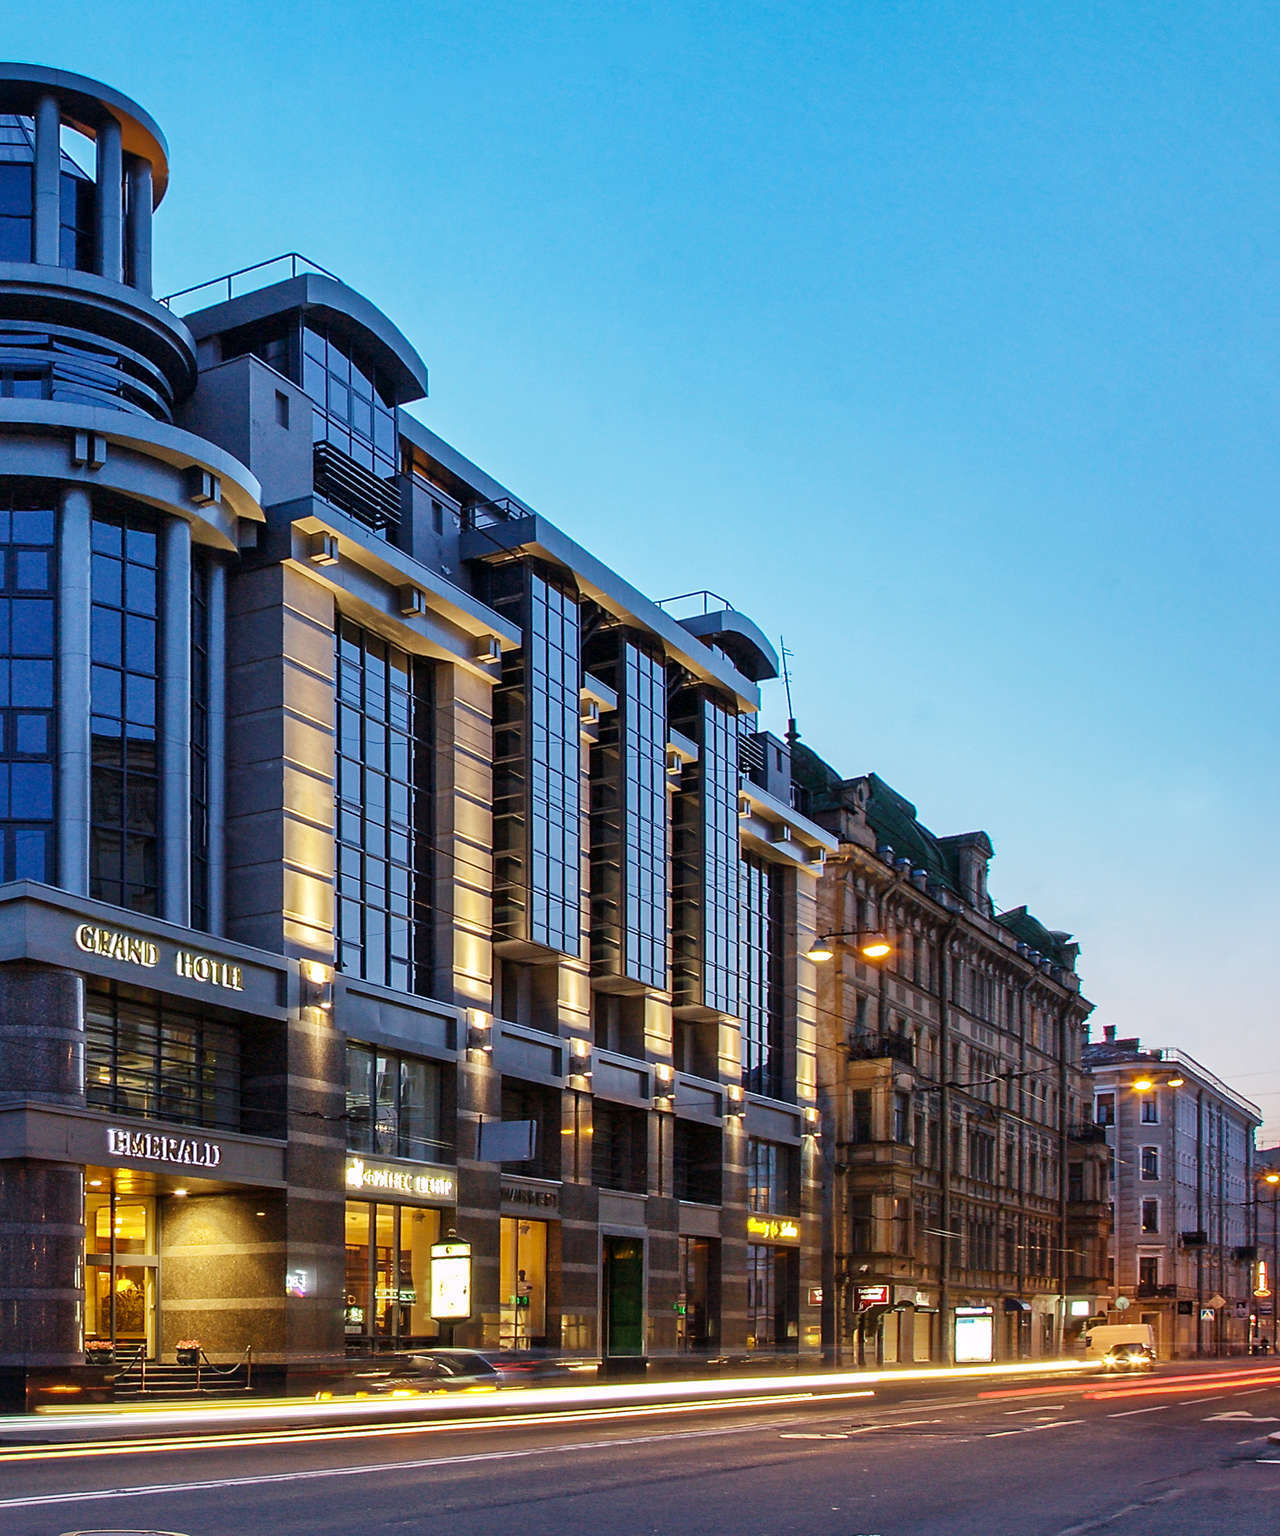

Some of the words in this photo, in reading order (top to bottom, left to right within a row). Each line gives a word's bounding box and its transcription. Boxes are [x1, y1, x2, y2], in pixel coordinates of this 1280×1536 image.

[75, 923, 160, 968] GRAND
[176, 950, 246, 992] HOTEL
[107, 1127, 221, 1168] EMERALD
